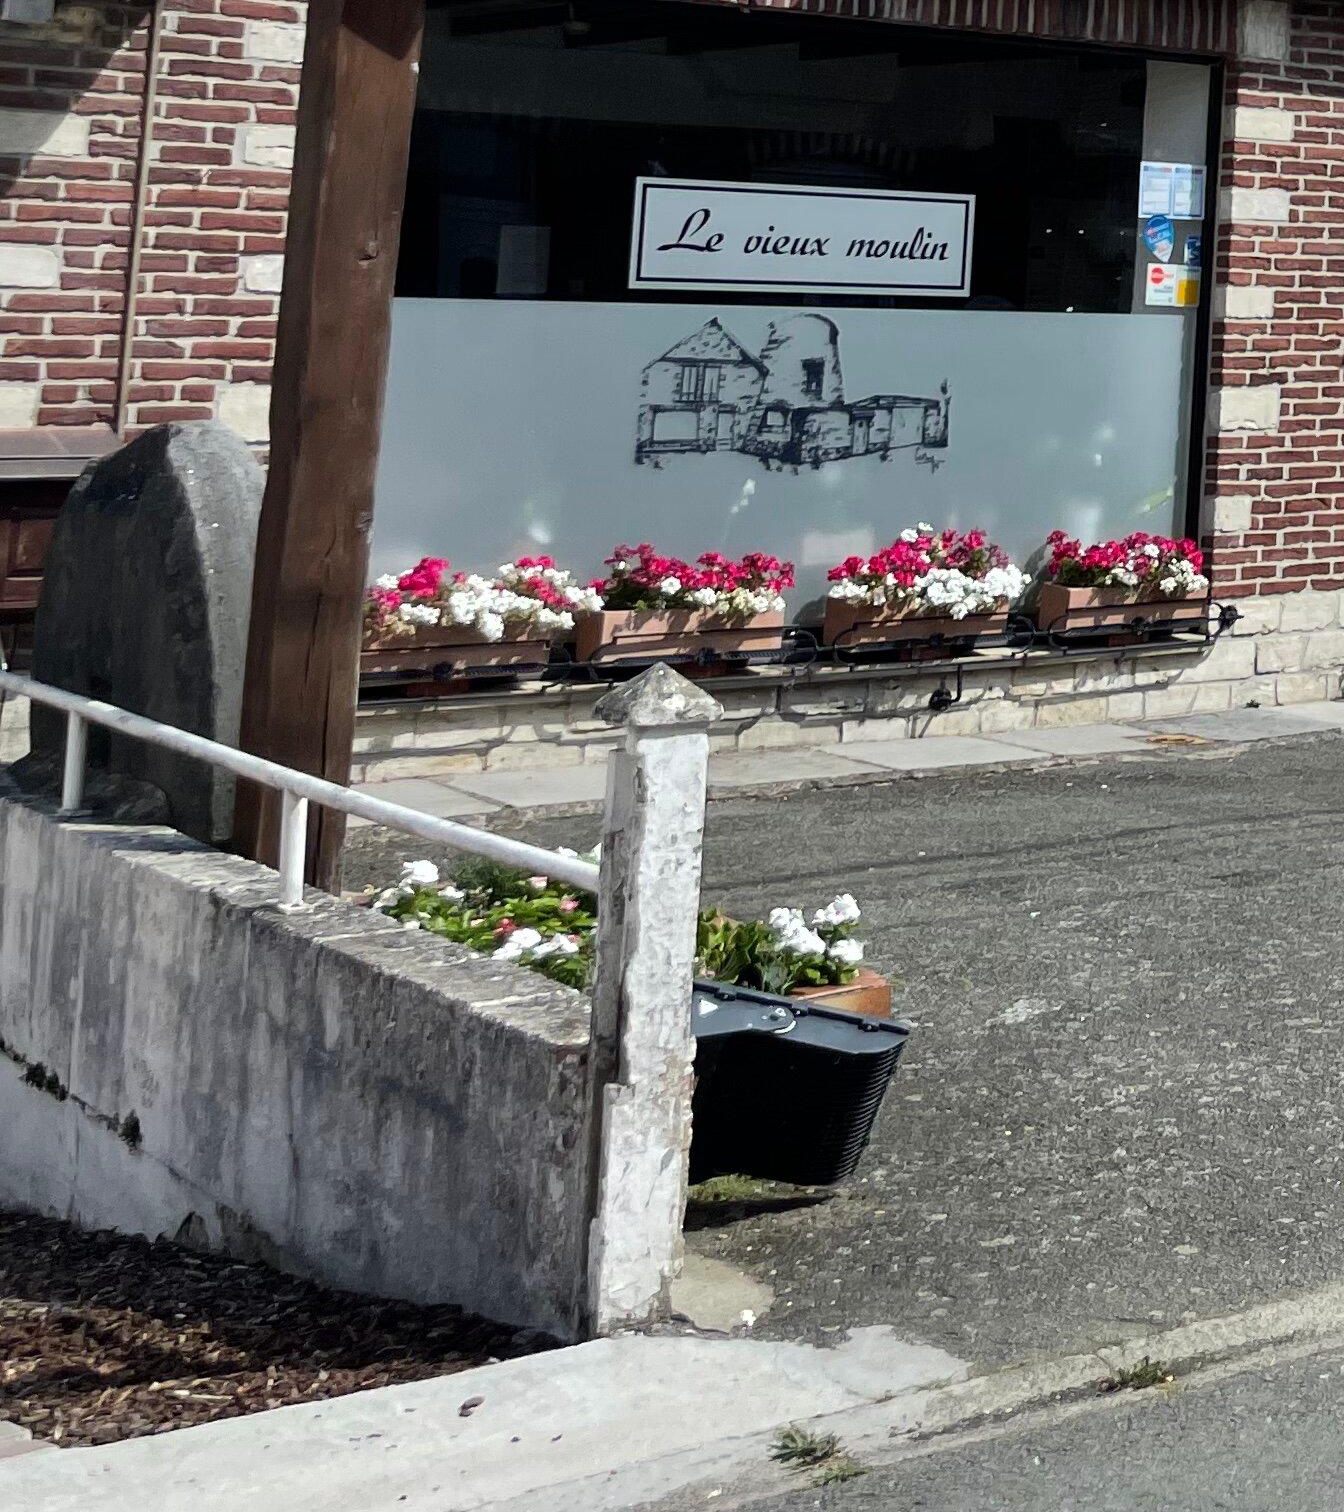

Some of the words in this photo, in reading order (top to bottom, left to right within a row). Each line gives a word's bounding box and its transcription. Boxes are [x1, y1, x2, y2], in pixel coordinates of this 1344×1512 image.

[656, 208, 724, 253] Le
[743, 225, 831, 257] vieux
[845, 227, 949, 261] moulin
